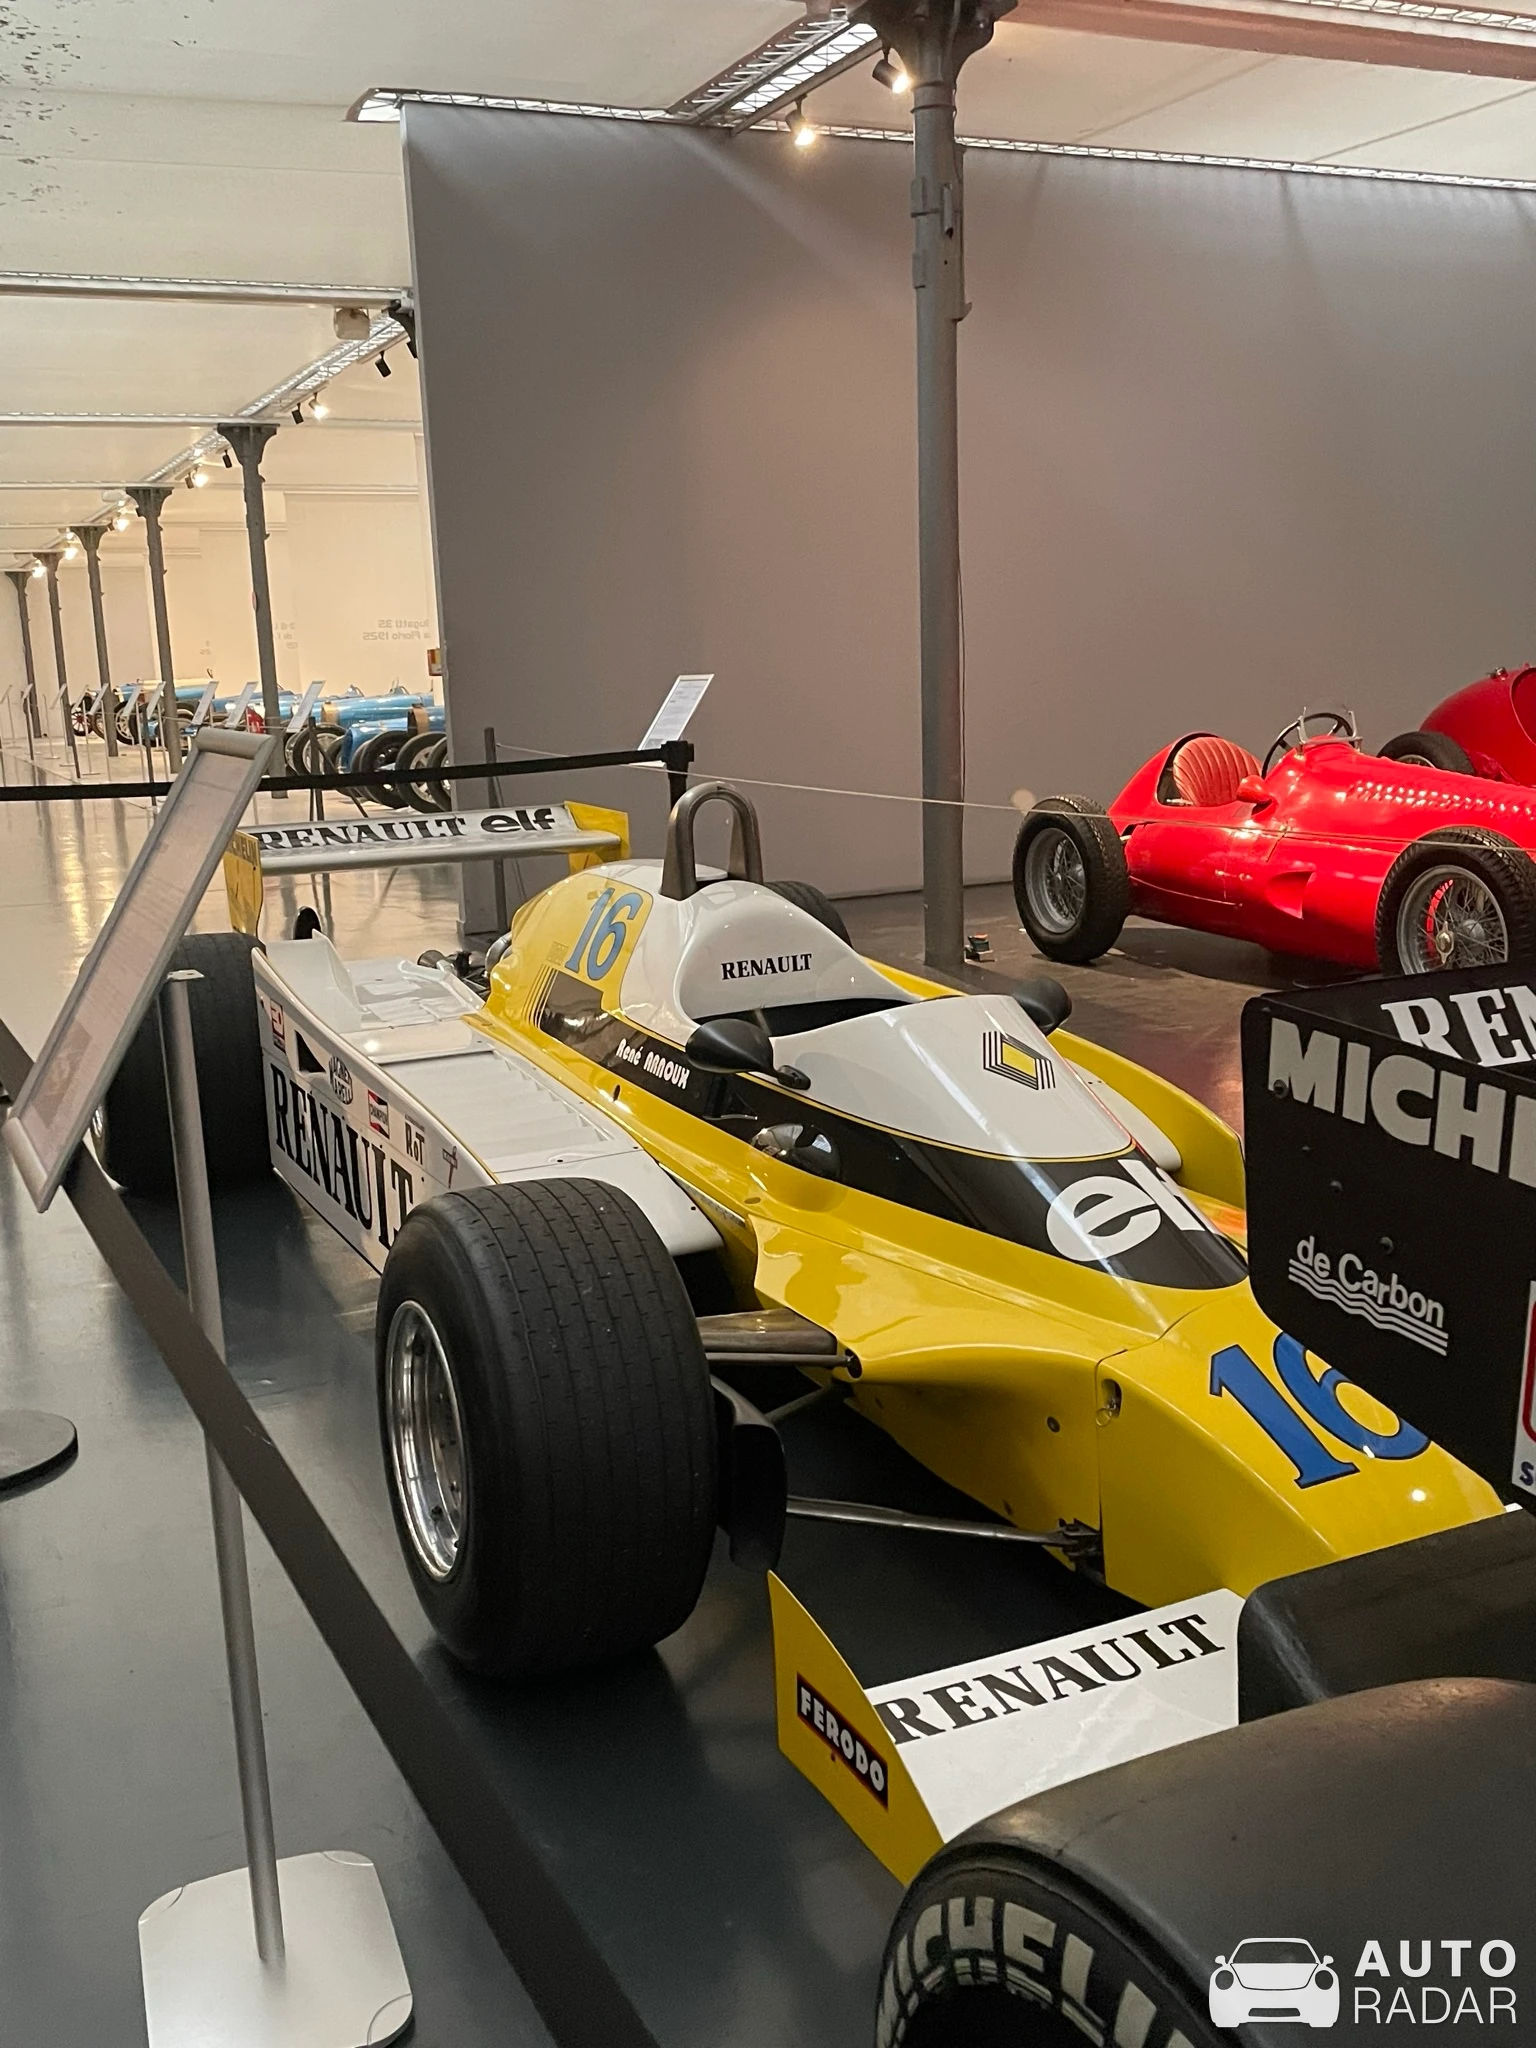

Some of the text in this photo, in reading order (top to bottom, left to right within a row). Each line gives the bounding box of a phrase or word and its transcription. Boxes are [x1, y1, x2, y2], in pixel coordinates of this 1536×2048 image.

[257, 807, 556, 850] RENAULT elf
[564, 887, 643, 981] 16
[721, 953, 813, 981] RENAULT
[616, 1038, 644, 1066] René
[271, 1064, 413, 1251] RENAULT
[1296, 1235, 1444, 1329] de Carbon
[1209, 1331, 1430, 1488] 16
[873, 1614, 1226, 1745] RENAULT
[800, 1686, 885, 1793] FERODO
